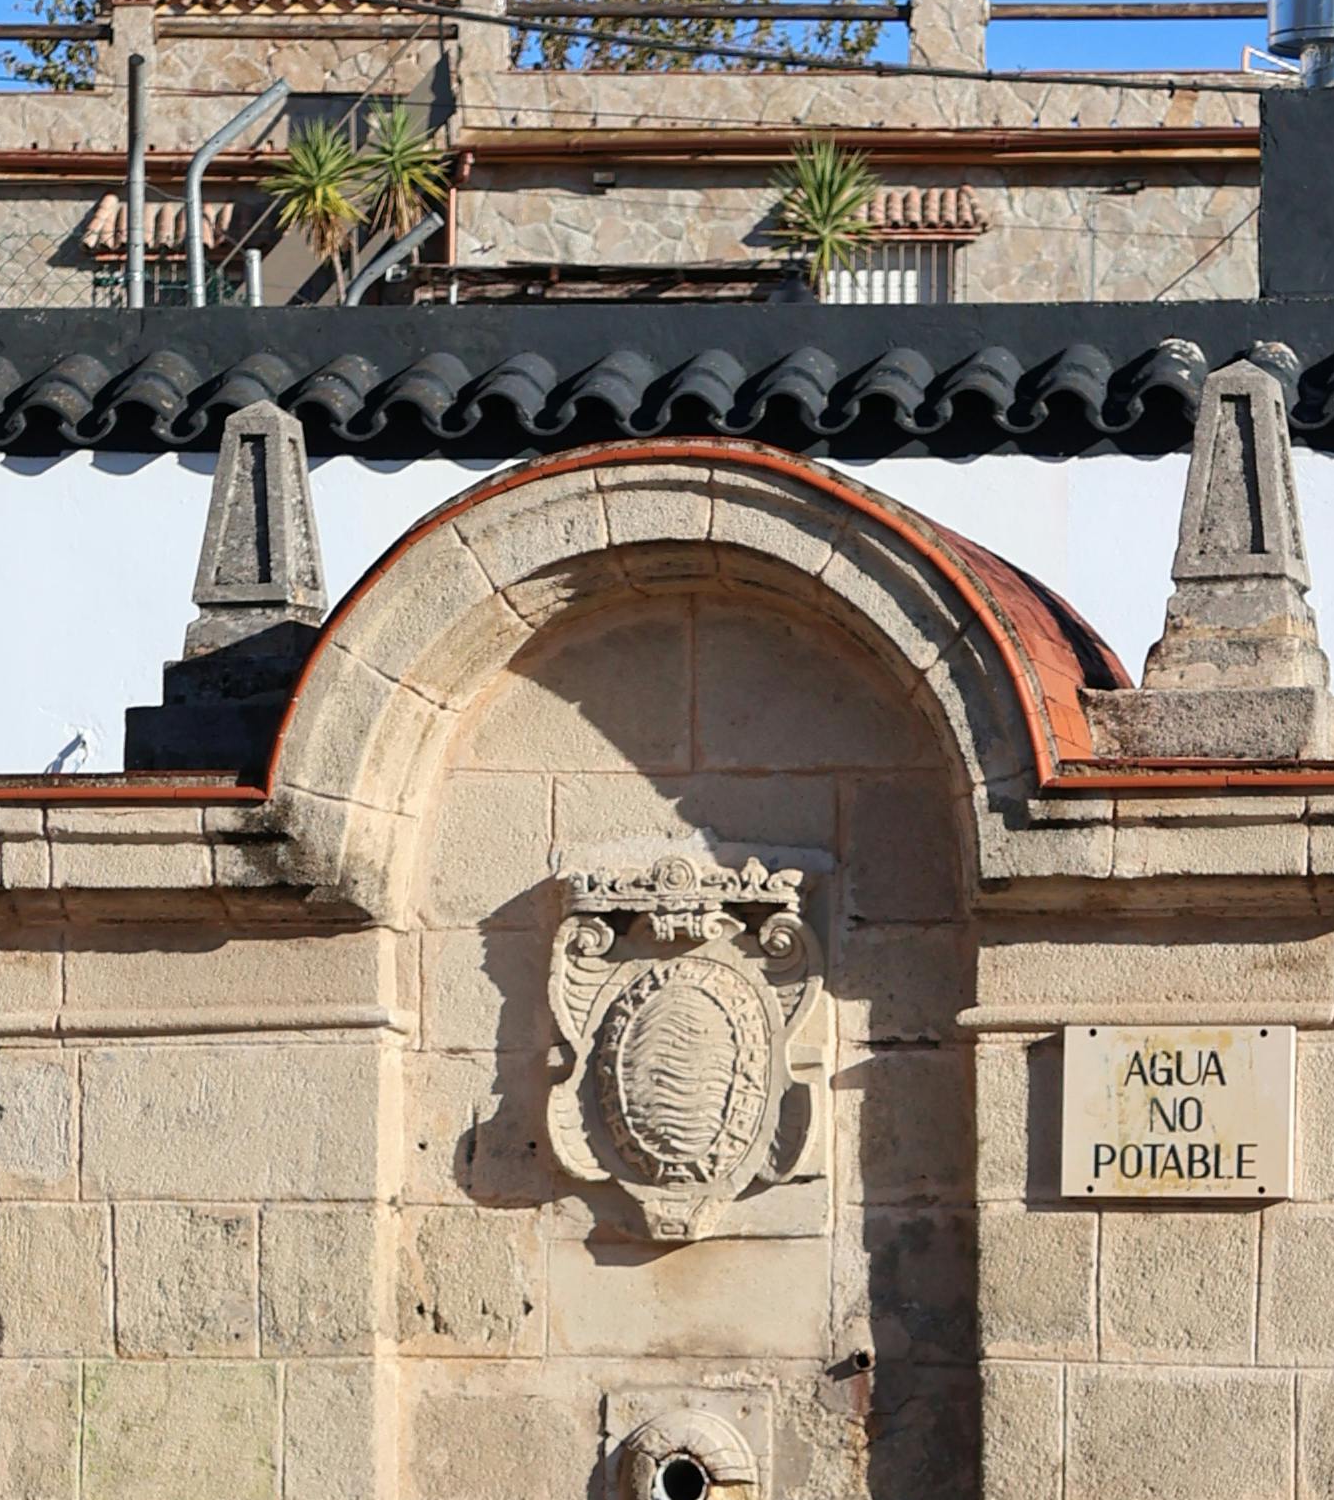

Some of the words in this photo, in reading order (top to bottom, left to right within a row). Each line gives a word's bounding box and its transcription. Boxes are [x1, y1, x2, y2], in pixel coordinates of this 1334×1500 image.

[1124, 1050, 1226, 1086] AGUA
[1149, 1096, 1203, 1133] NO
[1093, 1143, 1258, 1179] POTABLE
